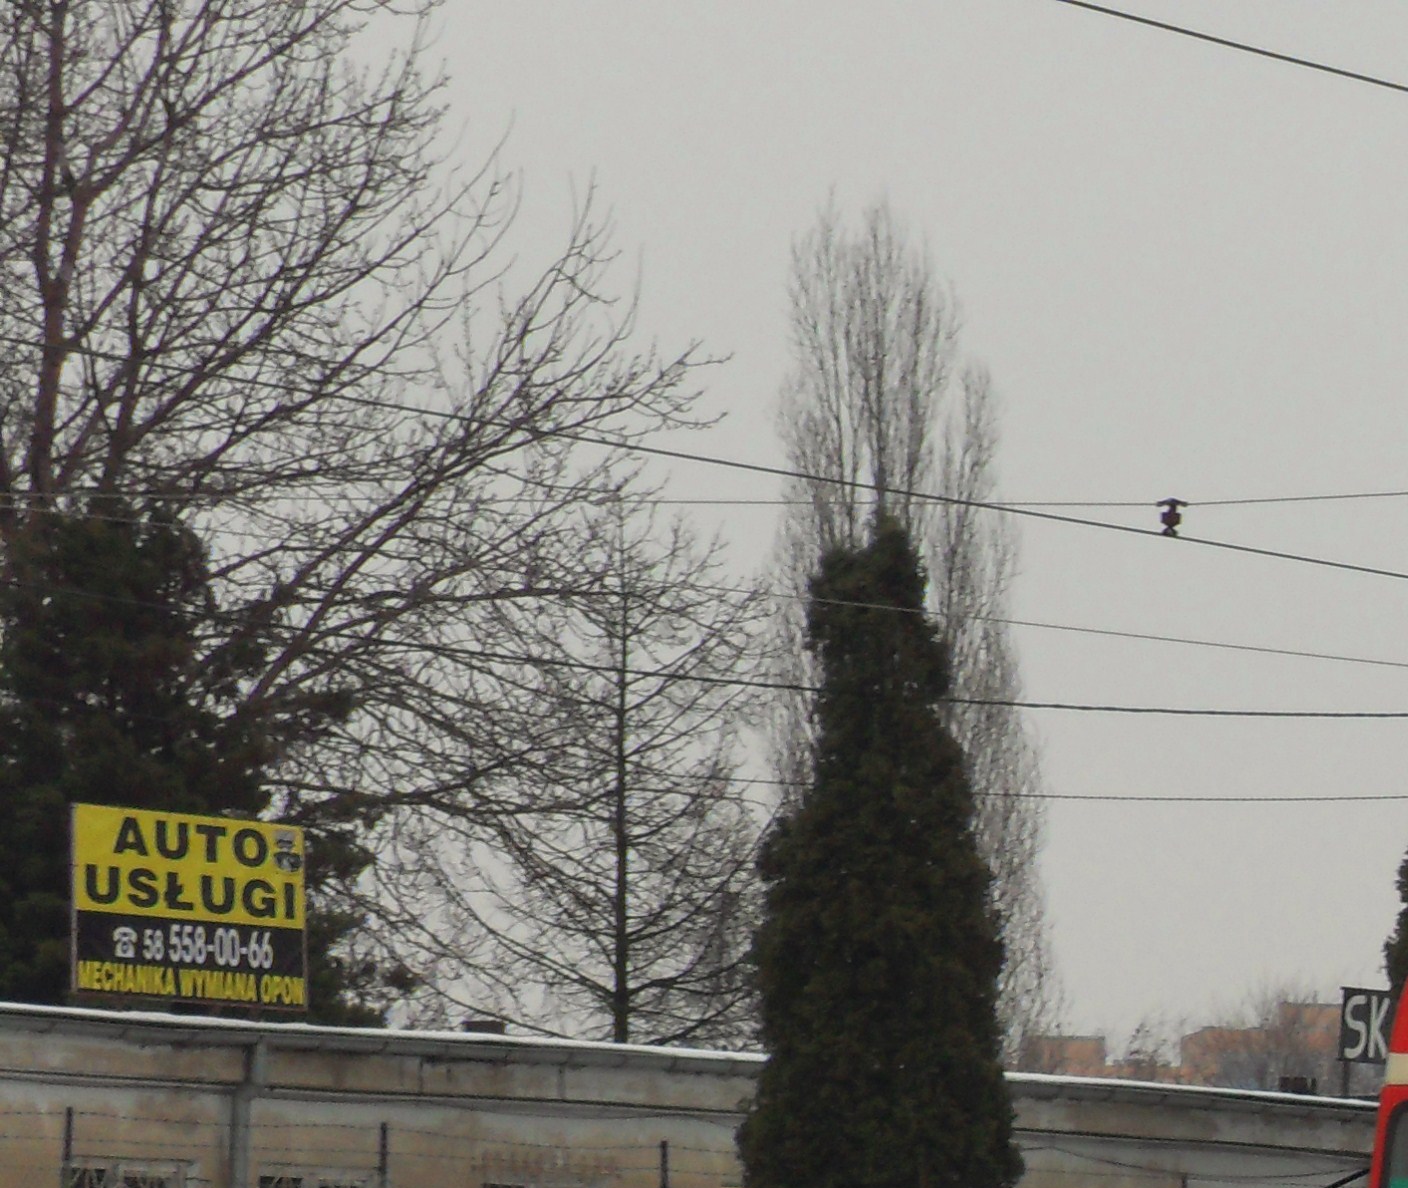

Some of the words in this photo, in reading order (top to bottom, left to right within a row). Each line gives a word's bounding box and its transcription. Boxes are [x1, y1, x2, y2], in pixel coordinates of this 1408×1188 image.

[113, 817, 269, 868] AUTO
[85, 864, 295, 919] USŁUGI
[143, 929, 165, 961] 58
[168, 924, 274, 969] 558-00-66
